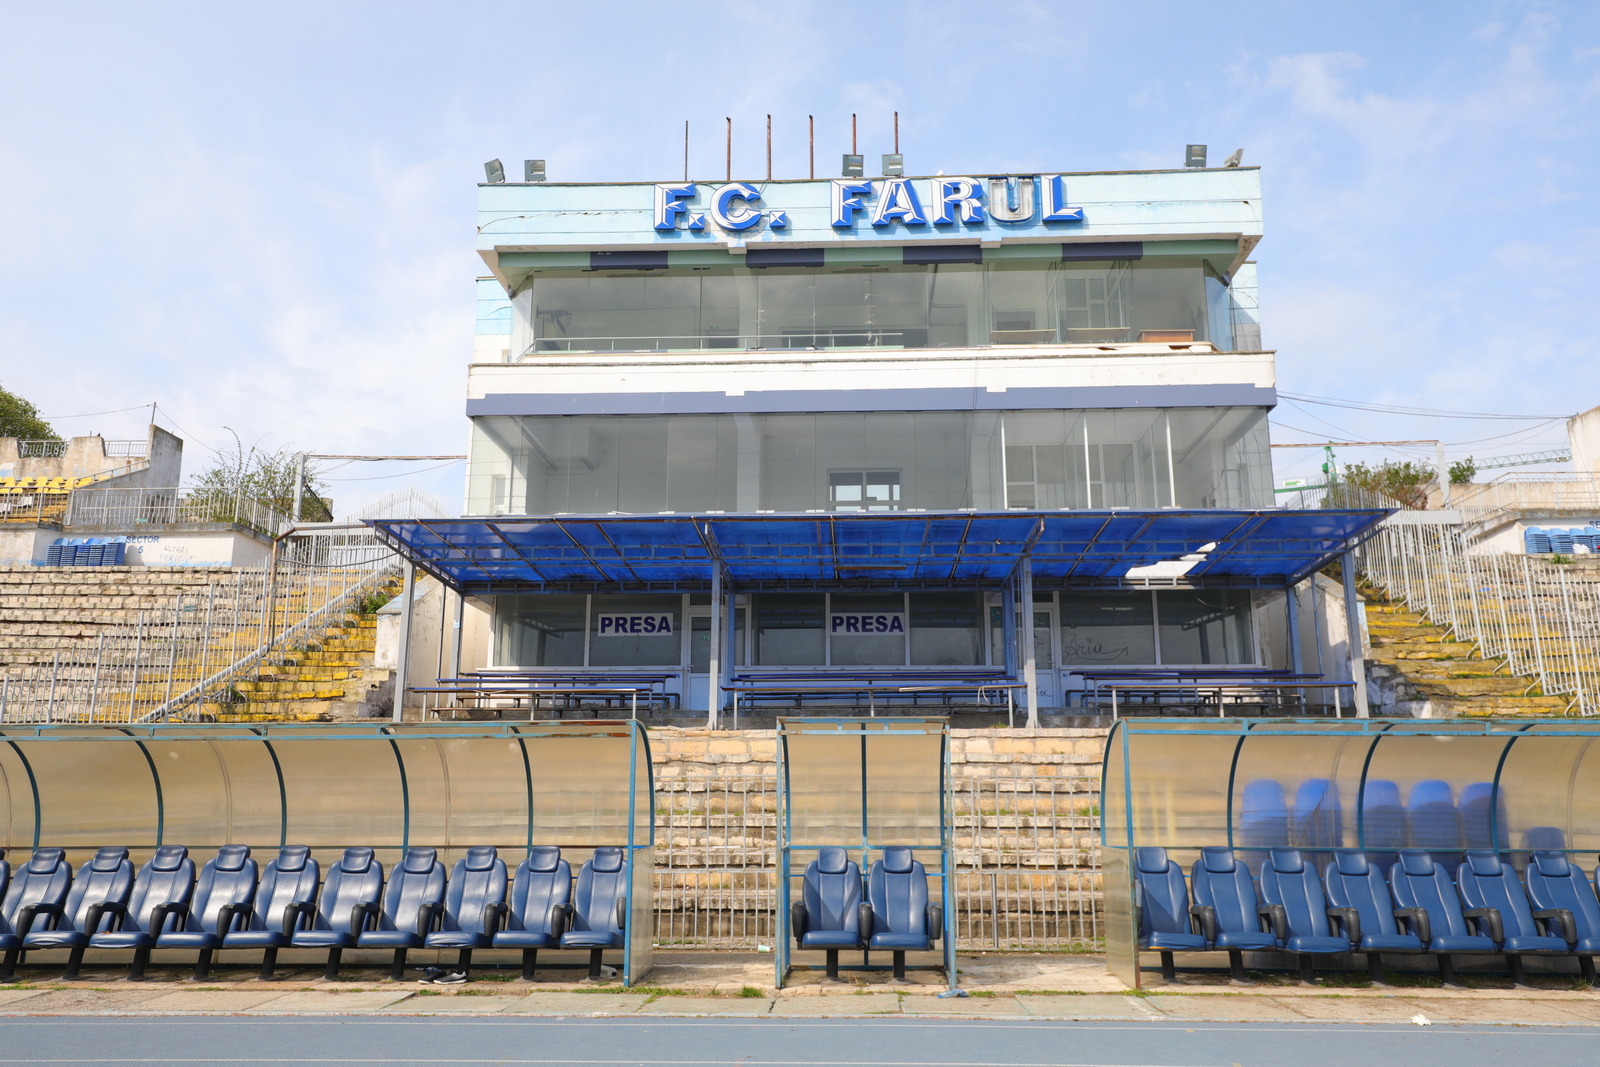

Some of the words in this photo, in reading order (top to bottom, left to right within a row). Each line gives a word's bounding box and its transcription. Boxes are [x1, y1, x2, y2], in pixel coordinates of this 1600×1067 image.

[654, 182, 787, 231] F.C.
[830, 174, 1084, 228] FARUL
[126, 535, 159, 543] SECTOR
[138, 546, 144, 554] 5
[600, 616, 672, 634] PRESA
[831, 615, 904, 633] PRESA
[1065, 633, 1120, 660] Aria
